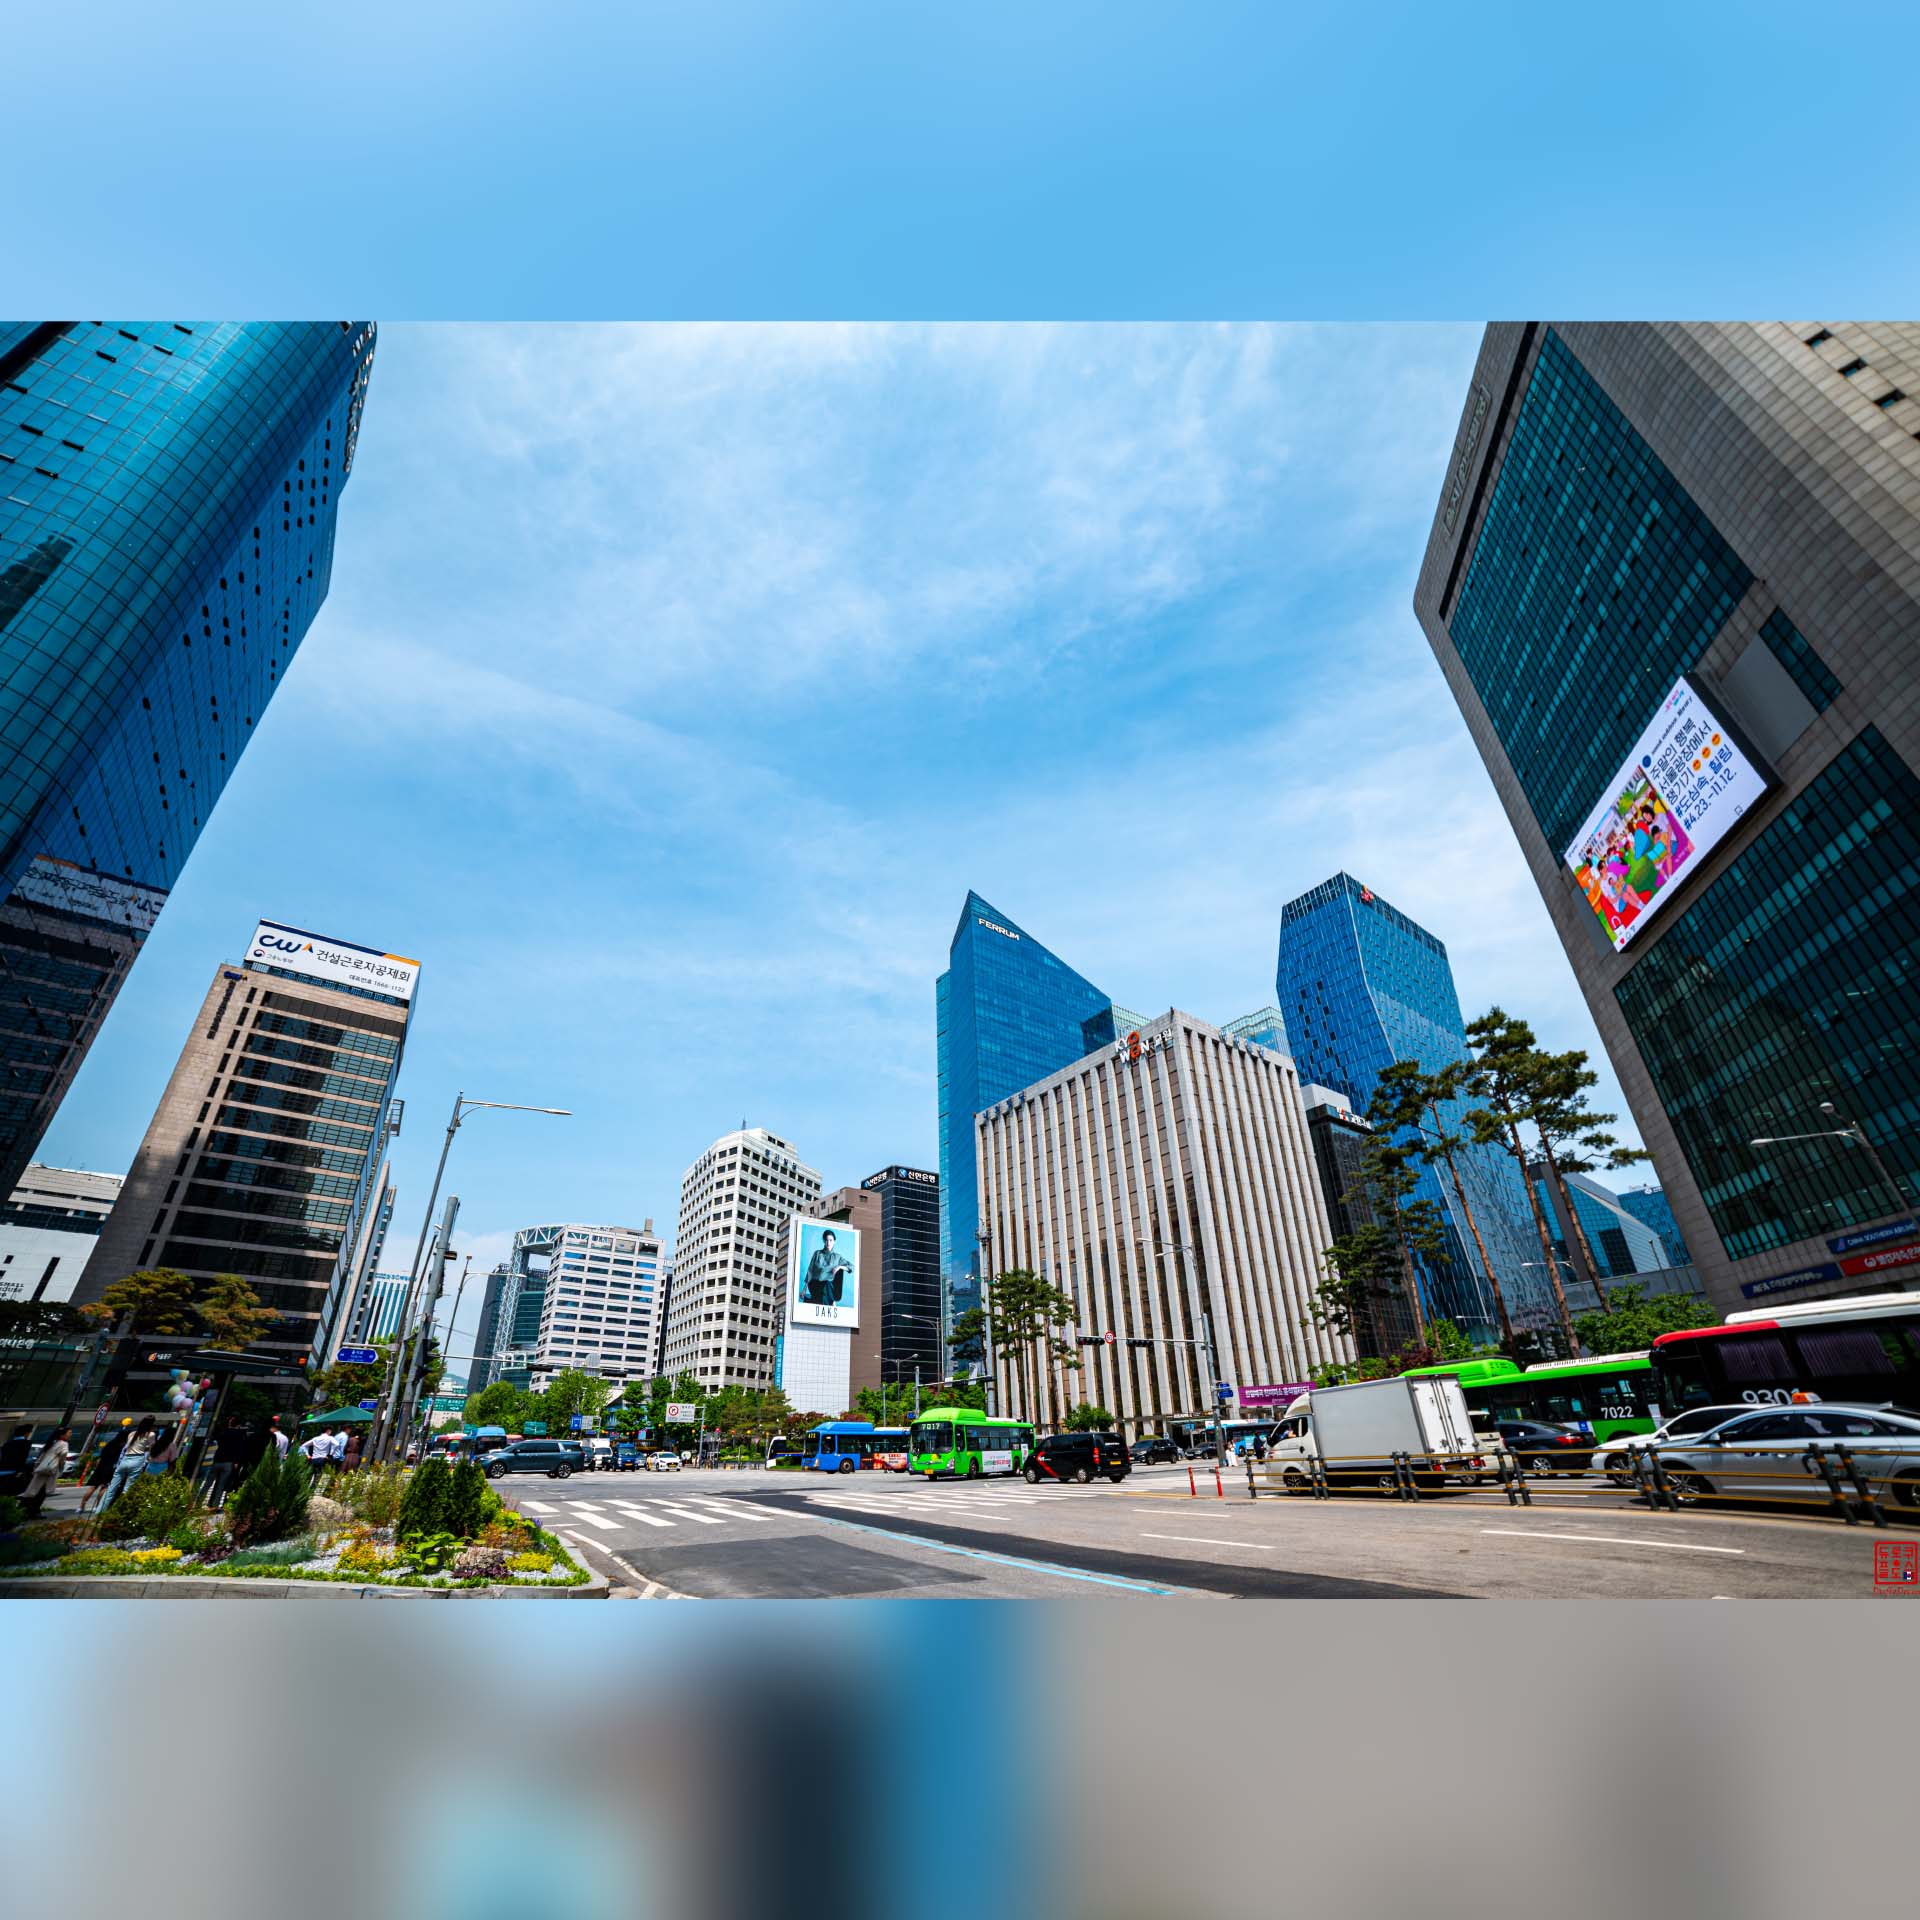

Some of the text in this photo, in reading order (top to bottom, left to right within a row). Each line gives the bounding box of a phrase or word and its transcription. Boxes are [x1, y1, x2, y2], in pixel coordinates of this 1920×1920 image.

[1650, 743, 1678, 781] 주말의
[1674, 718, 1697, 747] 행복
[1659, 720, 1712, 793] 서울광장에서
[1666, 767, 1695, 805] 챙기기
[978, 917, 1020, 941] FERRUM
[316, 949, 410, 981] 건설근로자공제회
[1154, 1028, 1172, 1046] 교원
[908, 1171, 936, 1184] 신한은행
[815, 1305, 838, 1319] DAKS
[1742, 1387, 1800, 1405] 930
[1600, 1405, 1635, 1420] 7022
[921, 1422, 940, 1431] 7017
